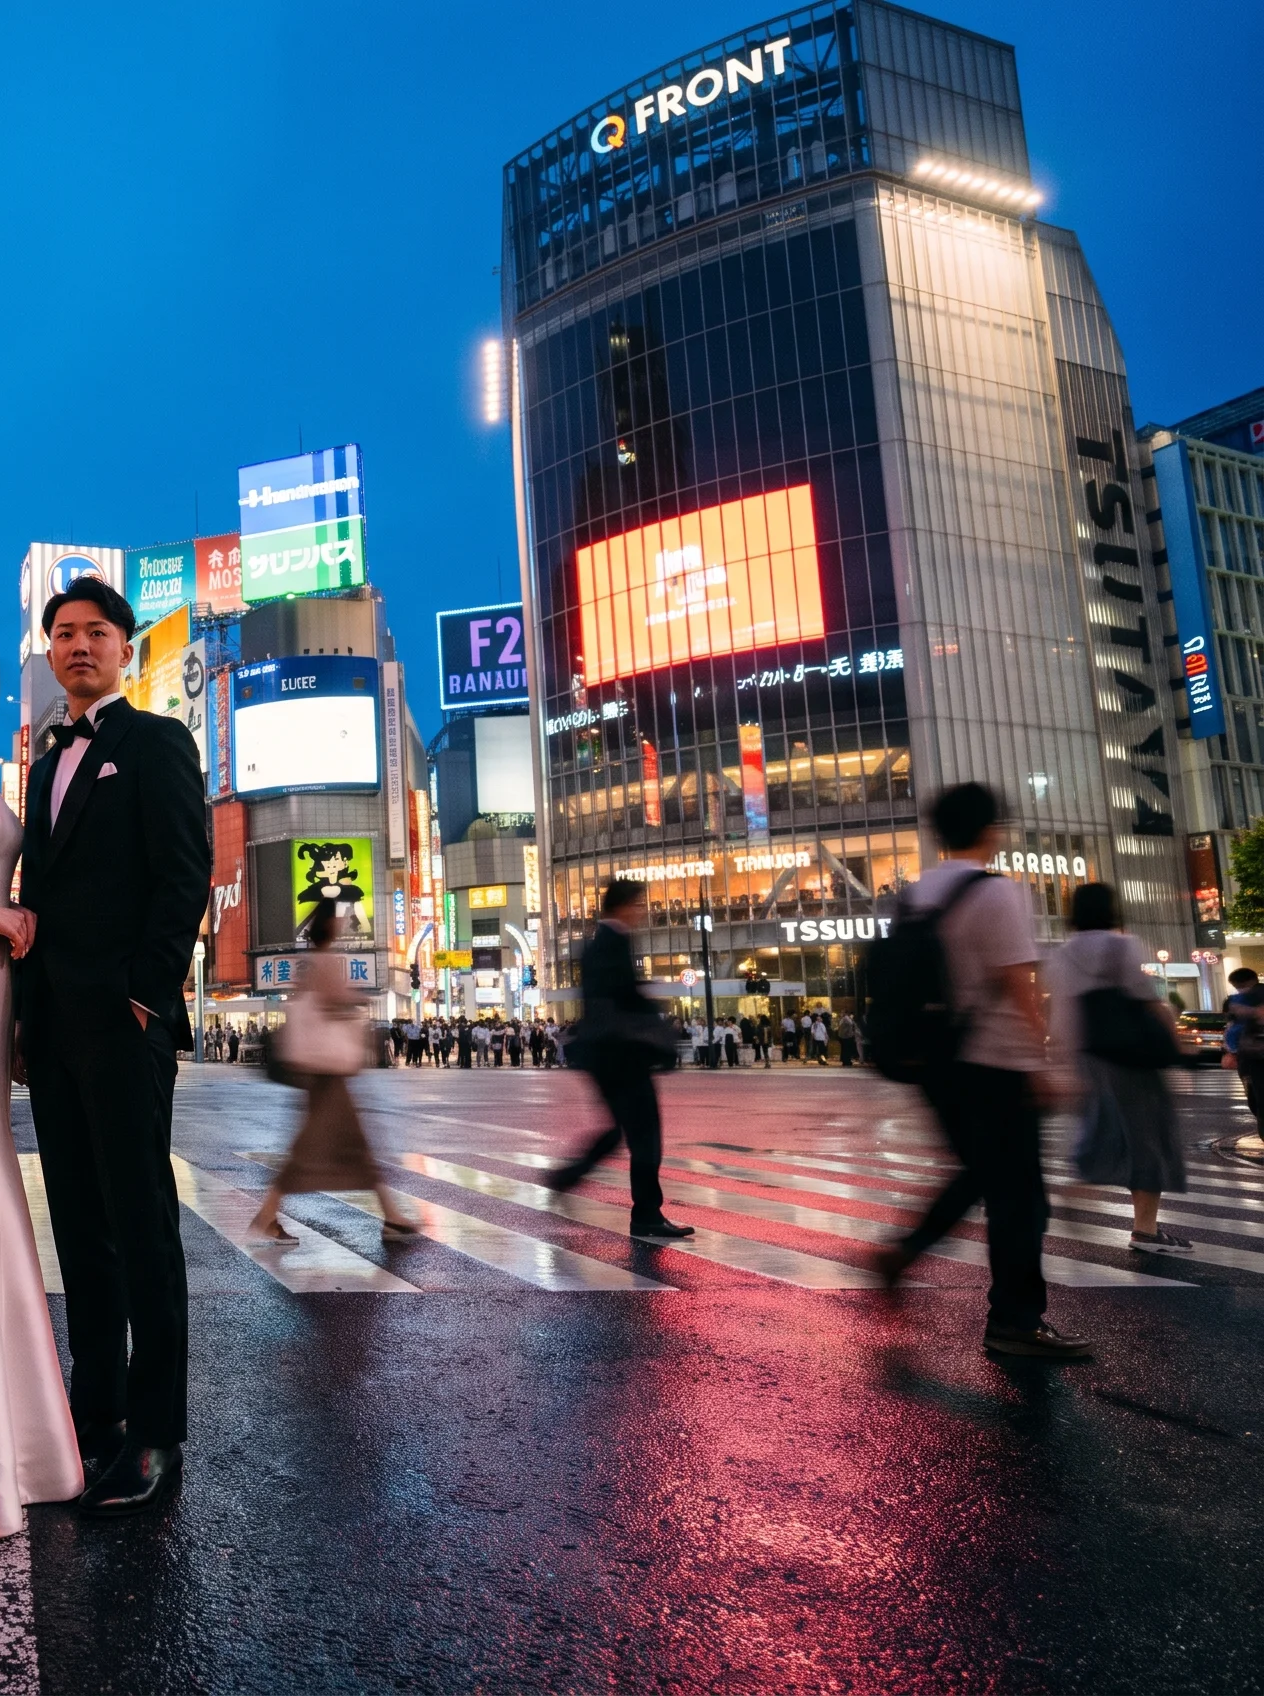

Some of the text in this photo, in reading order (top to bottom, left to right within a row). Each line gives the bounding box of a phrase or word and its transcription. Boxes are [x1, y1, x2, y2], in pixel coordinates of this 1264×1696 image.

[591, 36, 791, 154] Q FRONT
[469, 616, 522, 668] F2
